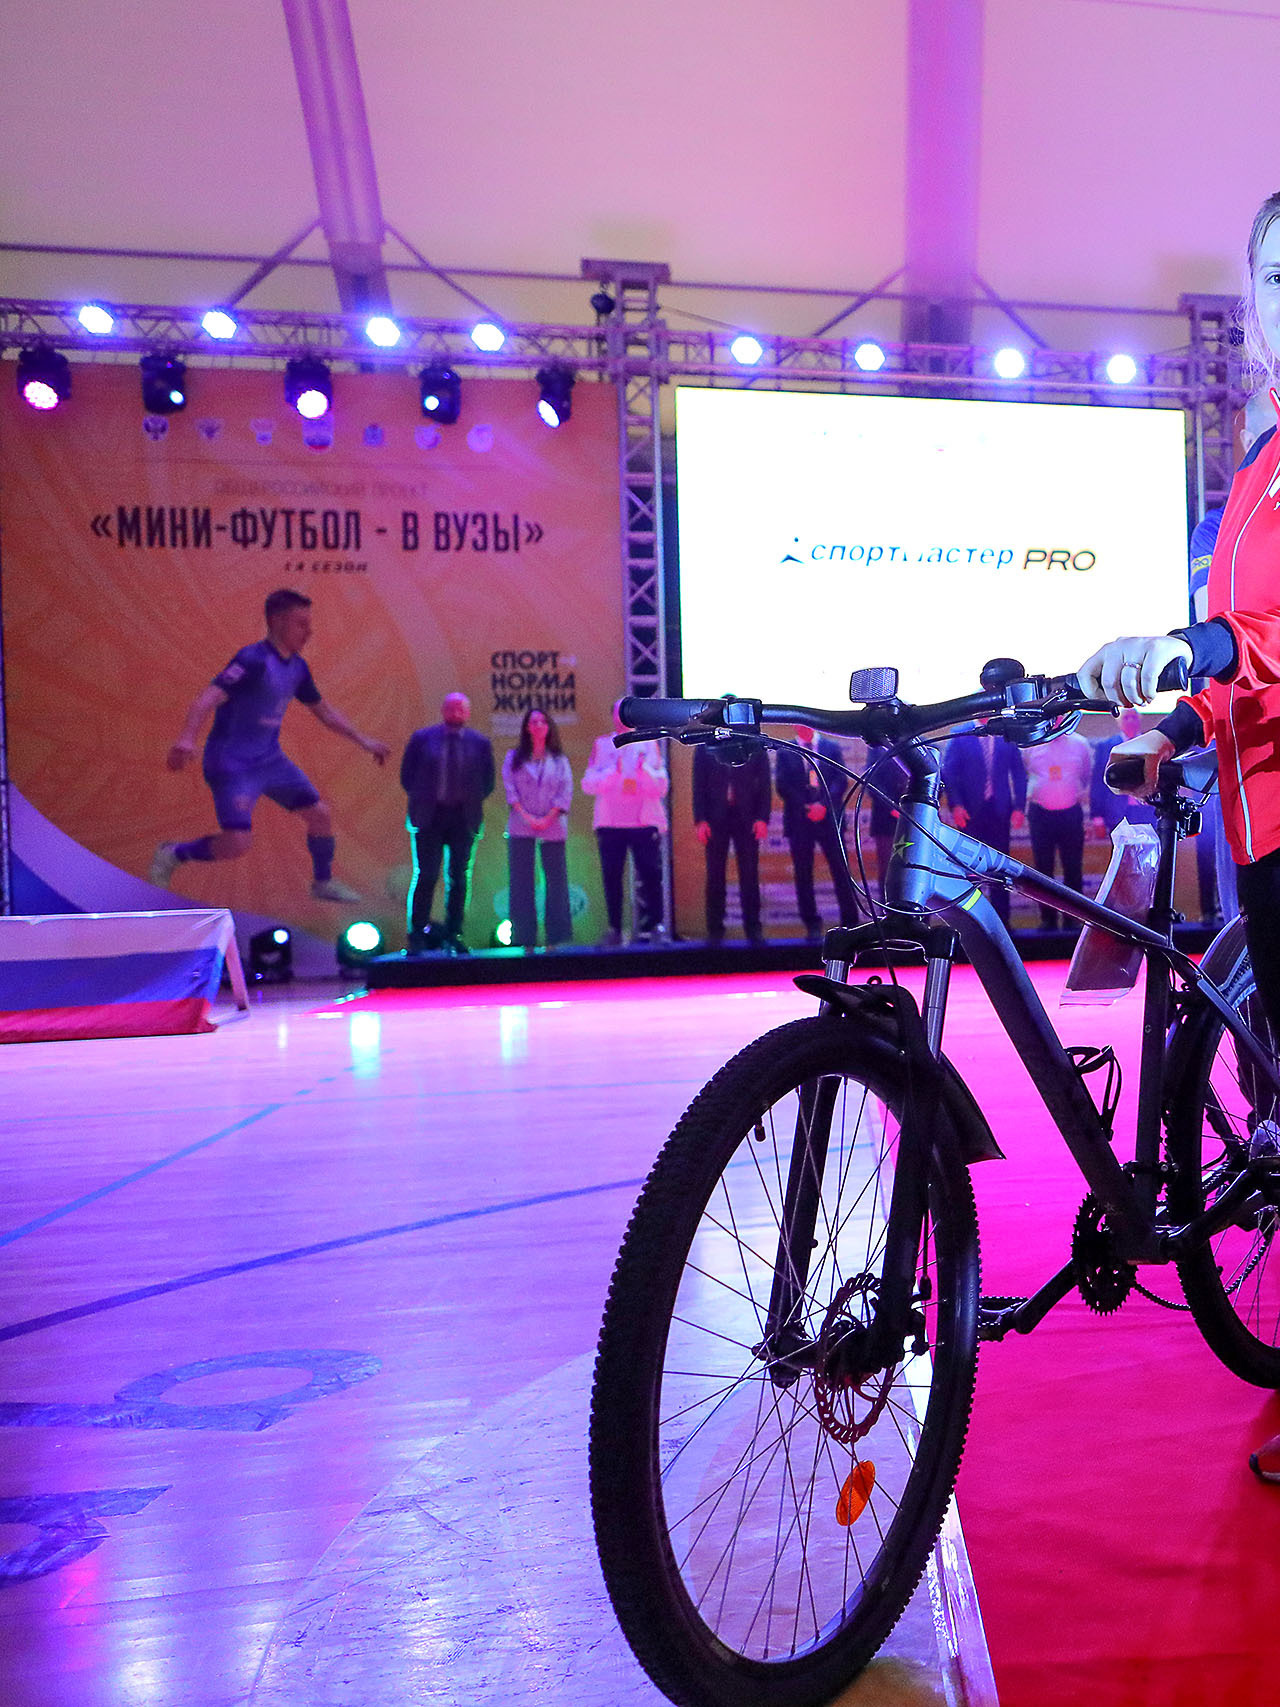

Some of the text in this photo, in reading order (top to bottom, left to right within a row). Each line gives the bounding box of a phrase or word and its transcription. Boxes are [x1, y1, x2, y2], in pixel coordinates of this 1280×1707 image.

[90, 505, 362, 551] «МИНИ-ФУТБОЛ
[402, 511, 420, 551] В
[433, 511, 545, 552] ВУЗЫ»
[1023, 549, 1096, 571] PRO
[490, 650, 559, 669] СПОРТ
[490, 672, 576, 690] НОРМА
[493, 694, 576, 712] ЖИЗНИ
